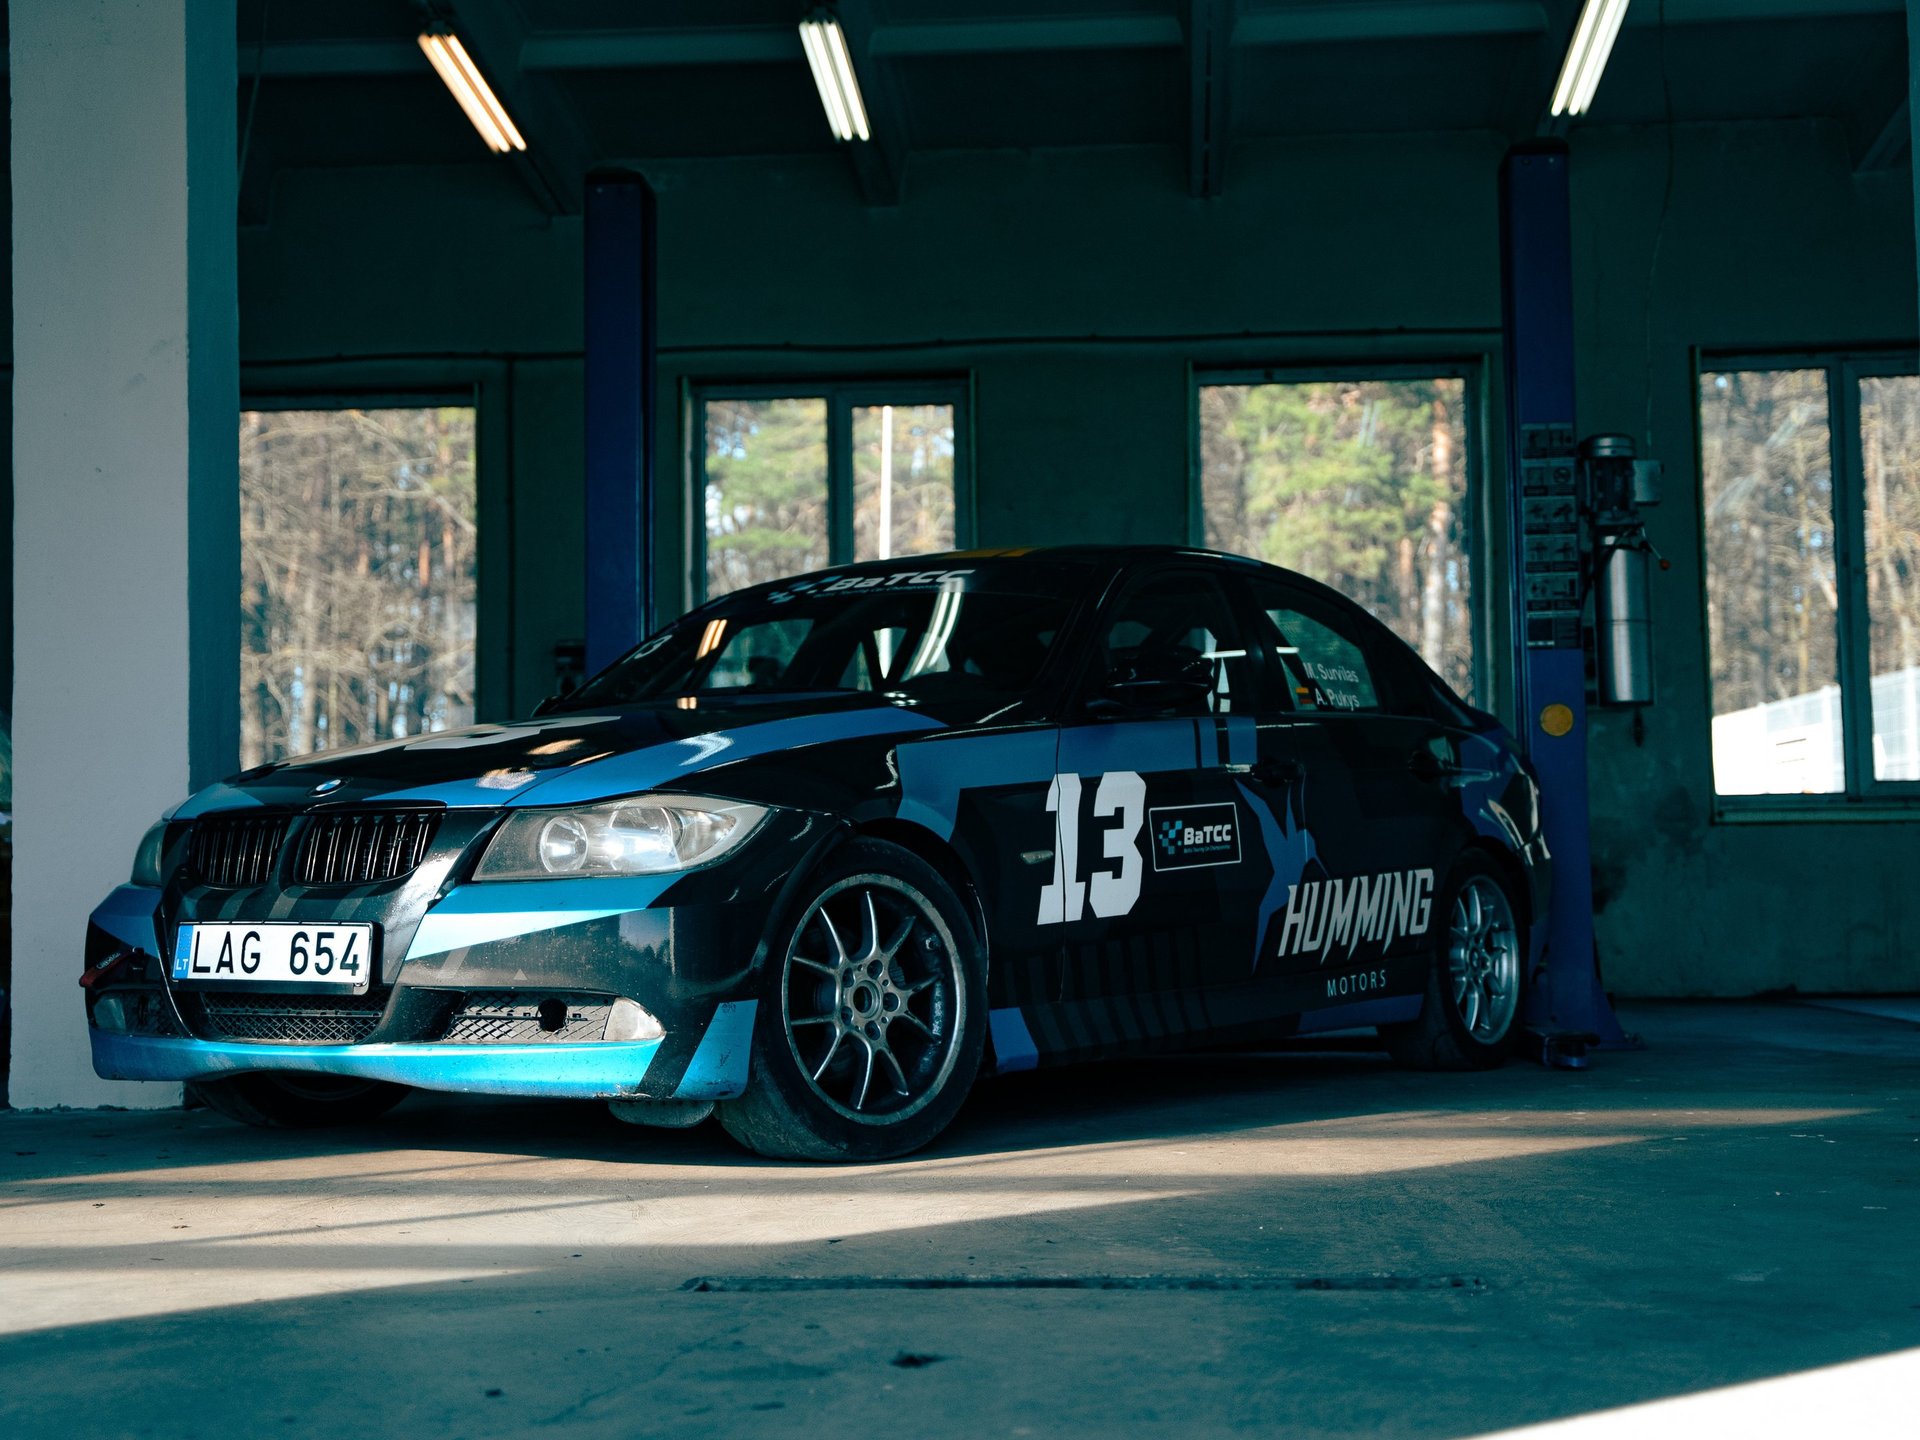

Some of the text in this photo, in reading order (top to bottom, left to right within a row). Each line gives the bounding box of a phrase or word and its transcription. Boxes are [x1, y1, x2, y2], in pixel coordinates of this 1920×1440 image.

[823, 569, 976, 592] BaTCC
[1317, 663, 1359, 683] Survilas
[1314, 687, 1360, 712] A. Pukys
[1183, 823, 1232, 846] BaTCC
[1036, 771, 1147, 926] 13
[1277, 868, 1434, 964] HUMMING
[175, 958, 189, 971] LT
[192, 931, 360, 976] LAG 654
[1326, 969, 1387, 997] MOTORS
